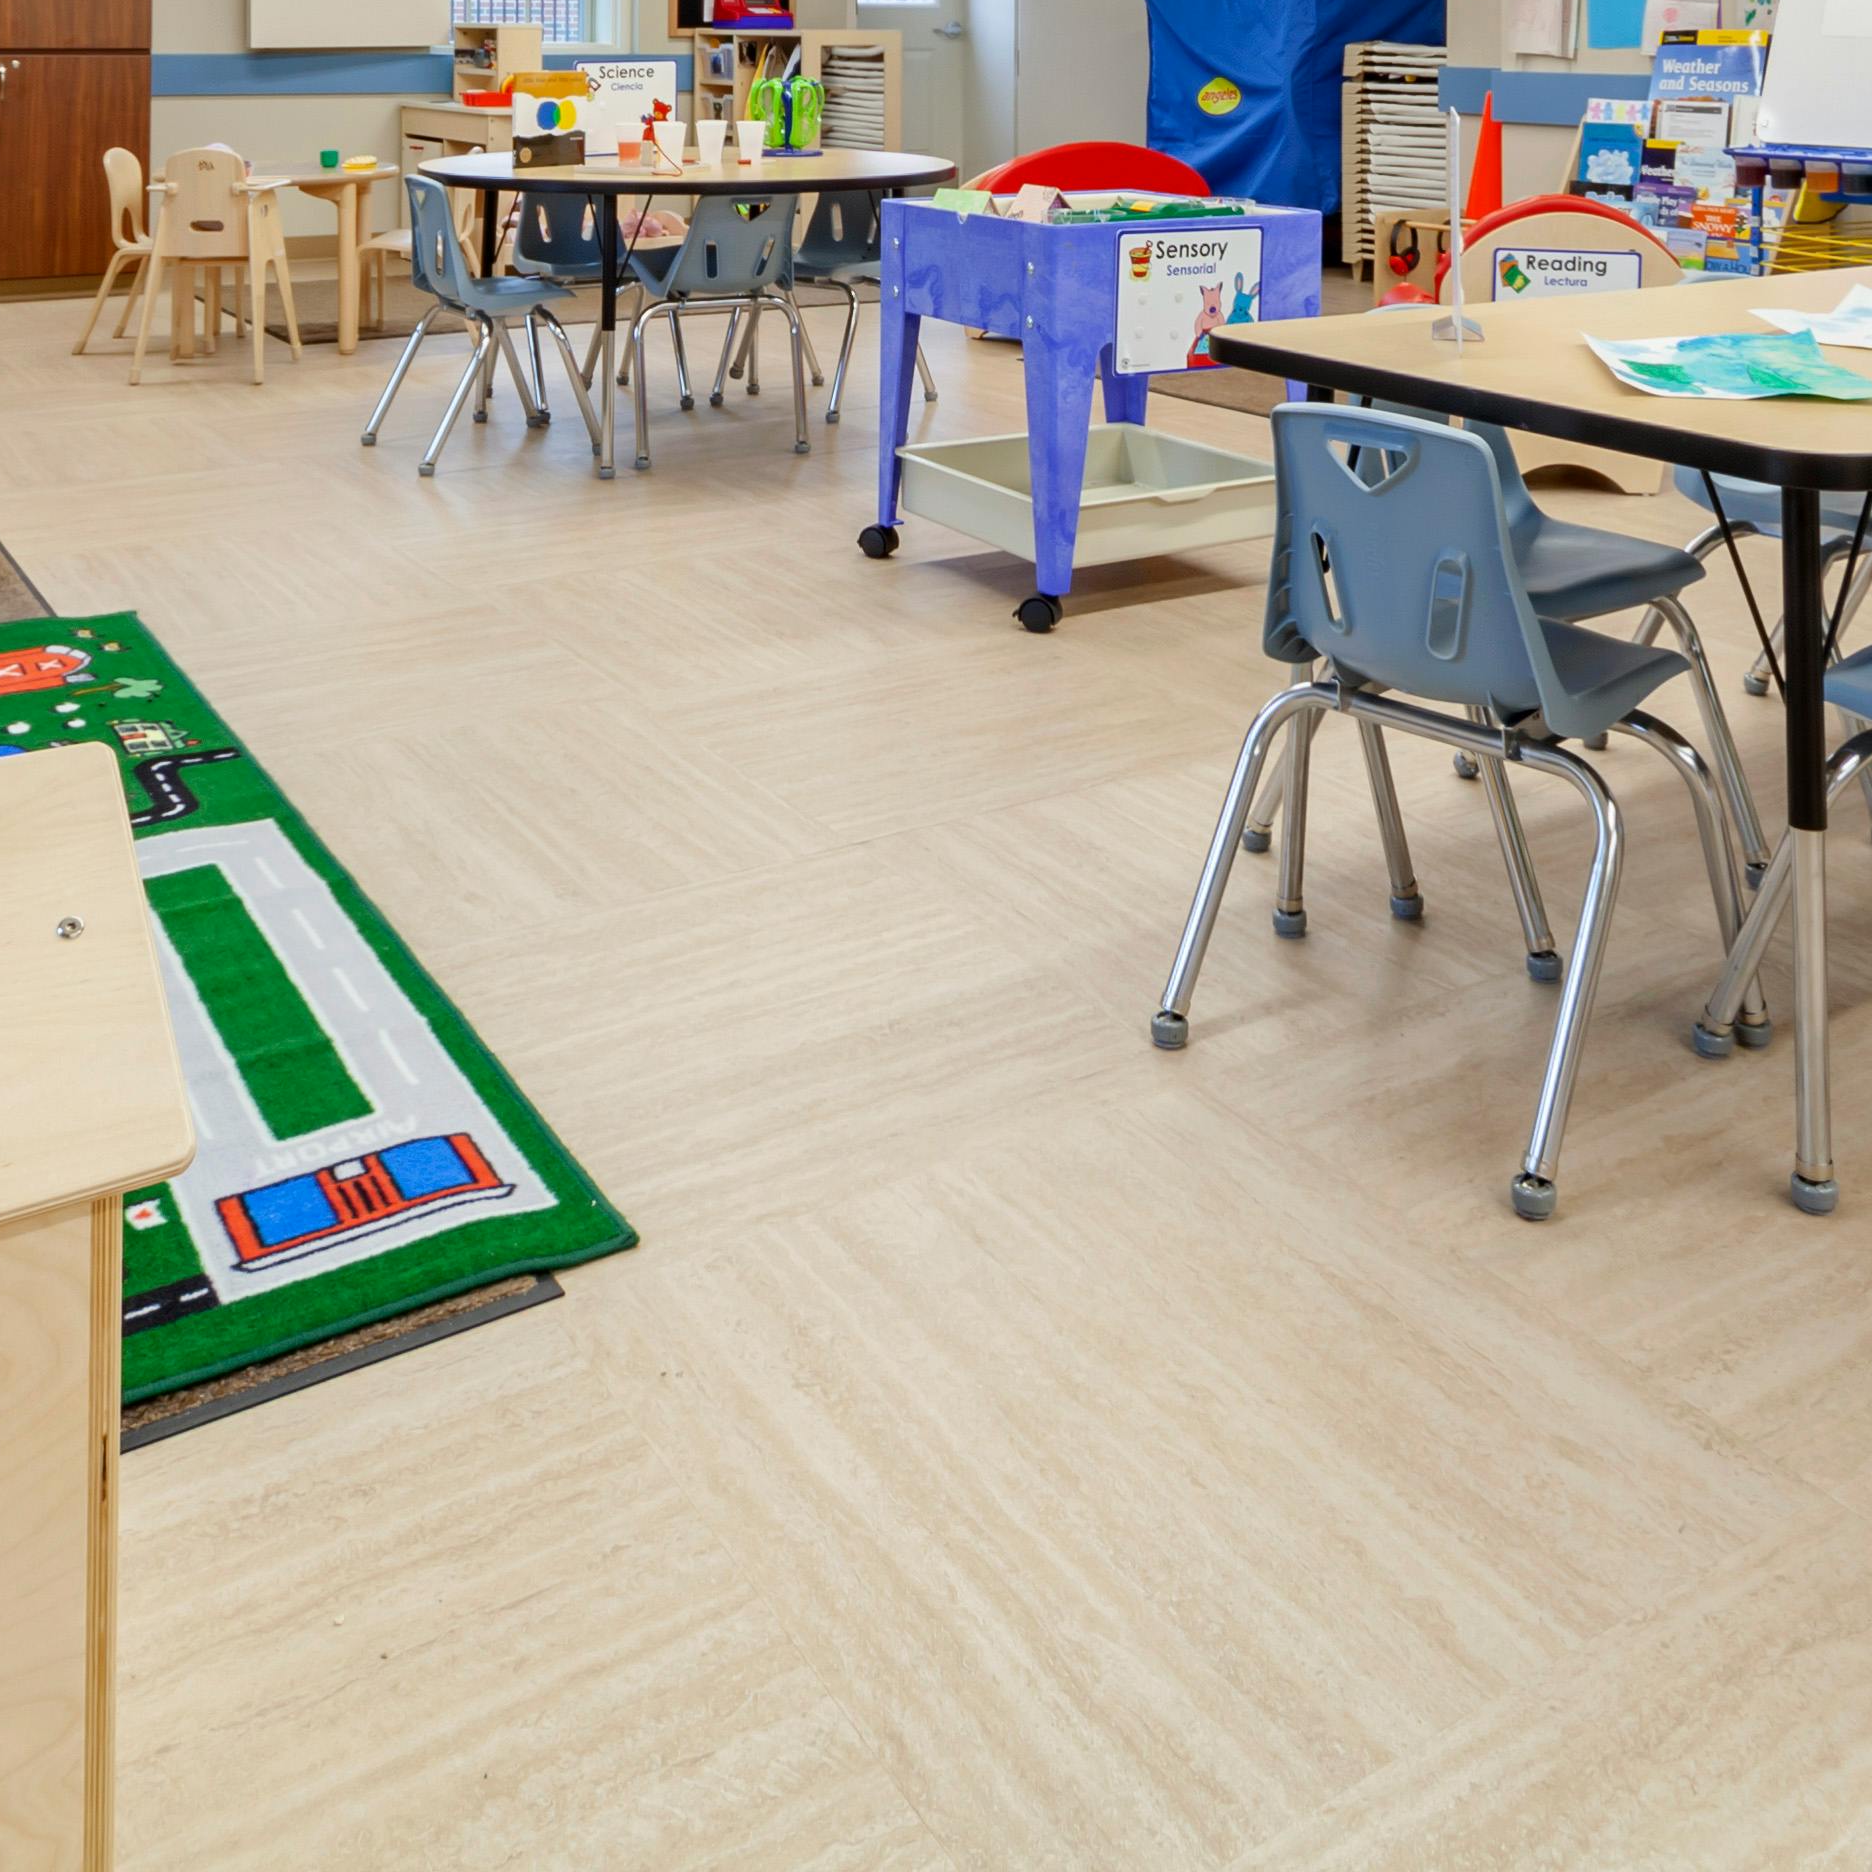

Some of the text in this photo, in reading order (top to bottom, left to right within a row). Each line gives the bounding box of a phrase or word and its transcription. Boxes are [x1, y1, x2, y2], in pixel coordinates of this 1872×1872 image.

[599, 65, 655, 80] Science
[1661, 58, 1722, 75] Weather
[611, 82, 644, 91] Ciencia
[1659, 76, 1749, 94] and Seasons
[1641, 164, 1677, 178] Weathe
[1155, 240, 1228, 261] Sensory
[1166, 262, 1217, 277] Sensorial
[1526, 255, 1608, 277] Reading
[1544, 275, 1588, 288] Lectura
[255, 1114, 418, 1176] AIRPORT
